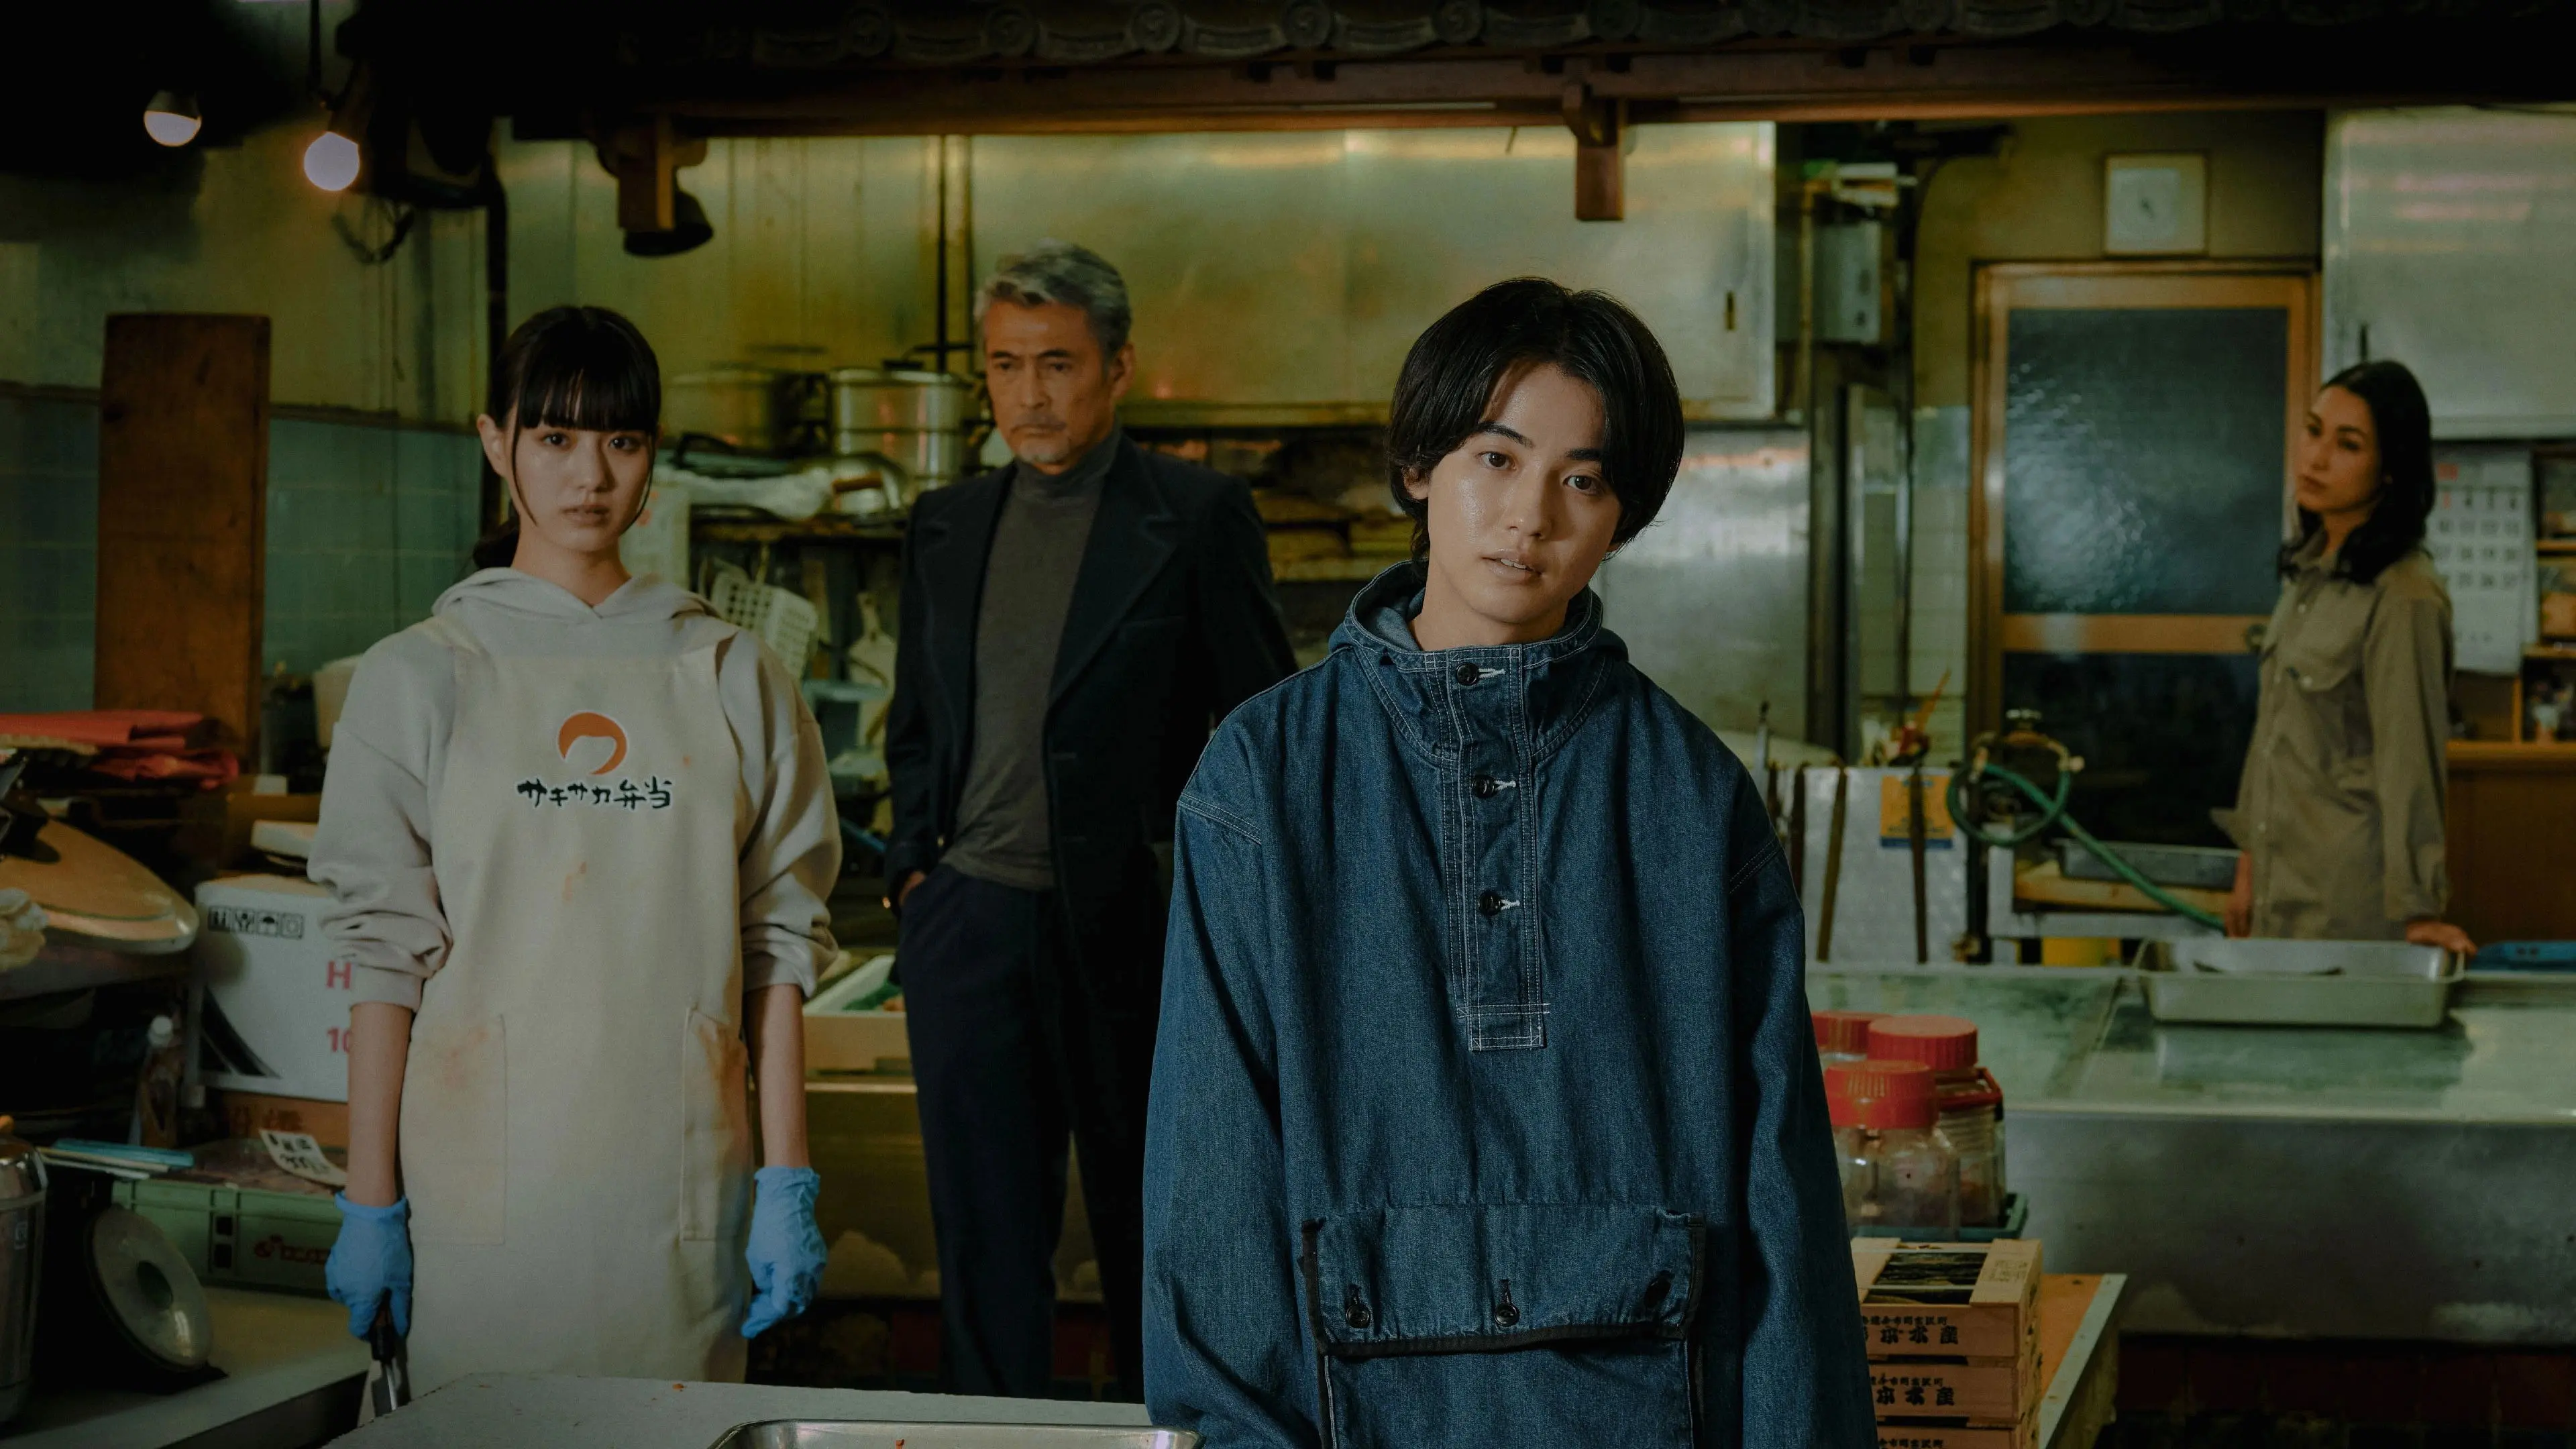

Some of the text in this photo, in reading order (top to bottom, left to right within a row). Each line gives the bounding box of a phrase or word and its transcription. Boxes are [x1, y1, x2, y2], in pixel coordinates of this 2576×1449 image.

[517, 775, 673, 810] サキサカ弁当
